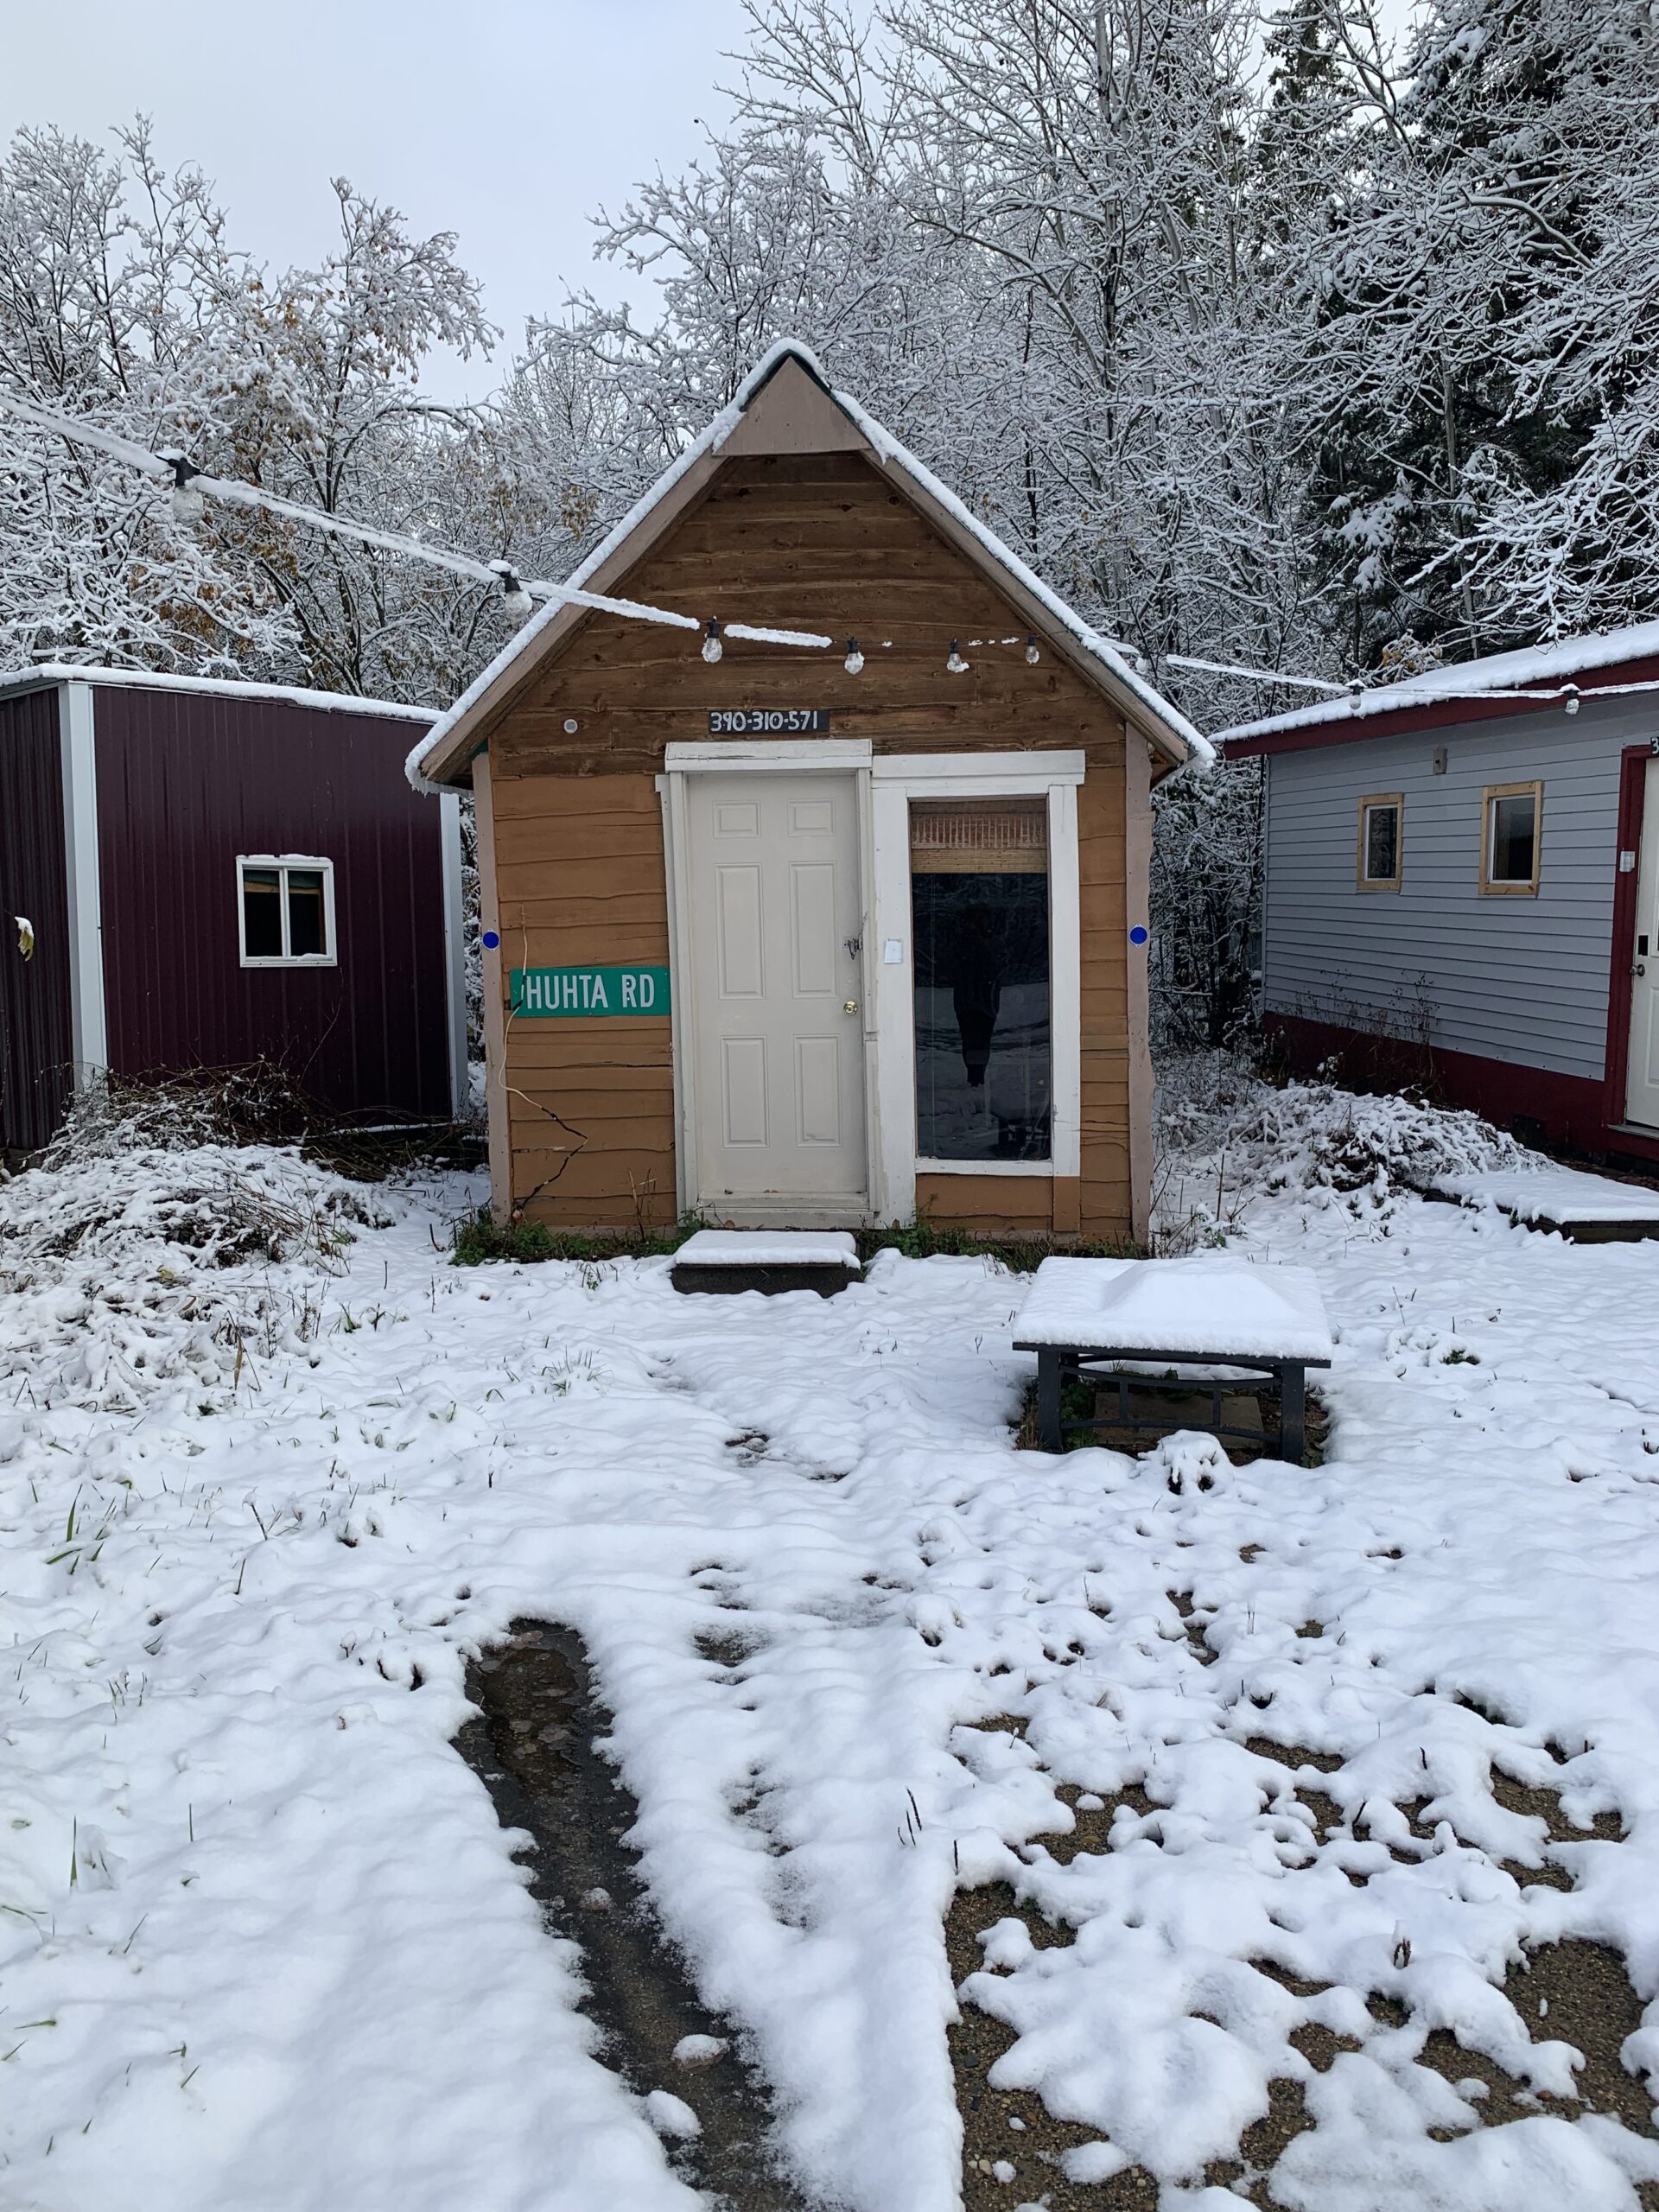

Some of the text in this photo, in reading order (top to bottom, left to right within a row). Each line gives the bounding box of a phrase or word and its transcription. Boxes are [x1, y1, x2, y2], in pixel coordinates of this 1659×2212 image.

[710, 710, 817, 732] 390-310-571
[526, 974, 655, 1009] HUHTA RD
